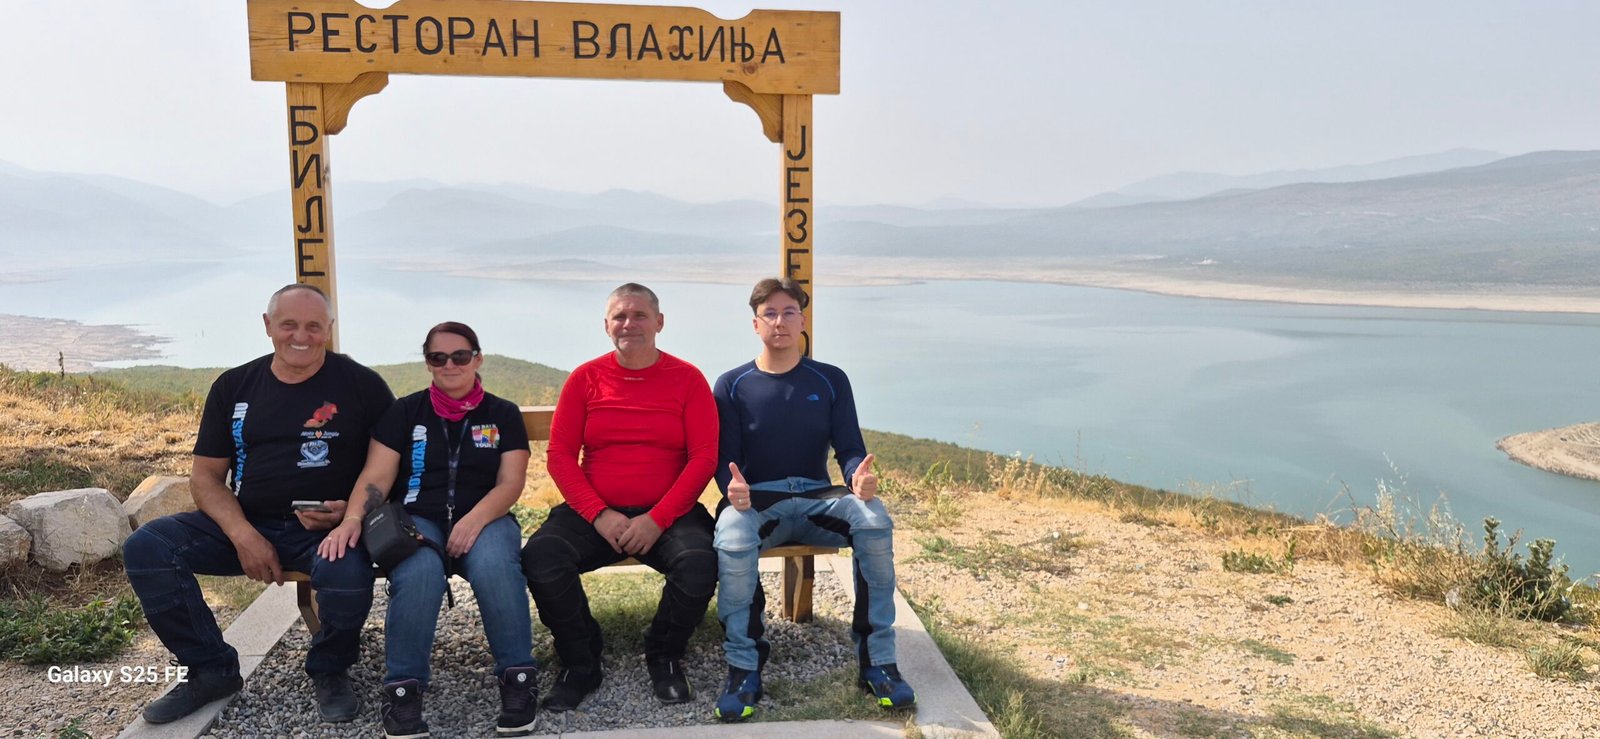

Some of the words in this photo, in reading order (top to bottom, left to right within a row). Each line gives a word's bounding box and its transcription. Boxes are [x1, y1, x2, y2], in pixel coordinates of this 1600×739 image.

[287, 11, 539, 58] РЕСТОРАН
[572, 20, 785, 64] ВЛАХИЊА
[289, 105, 325, 280] БИЛЕ
